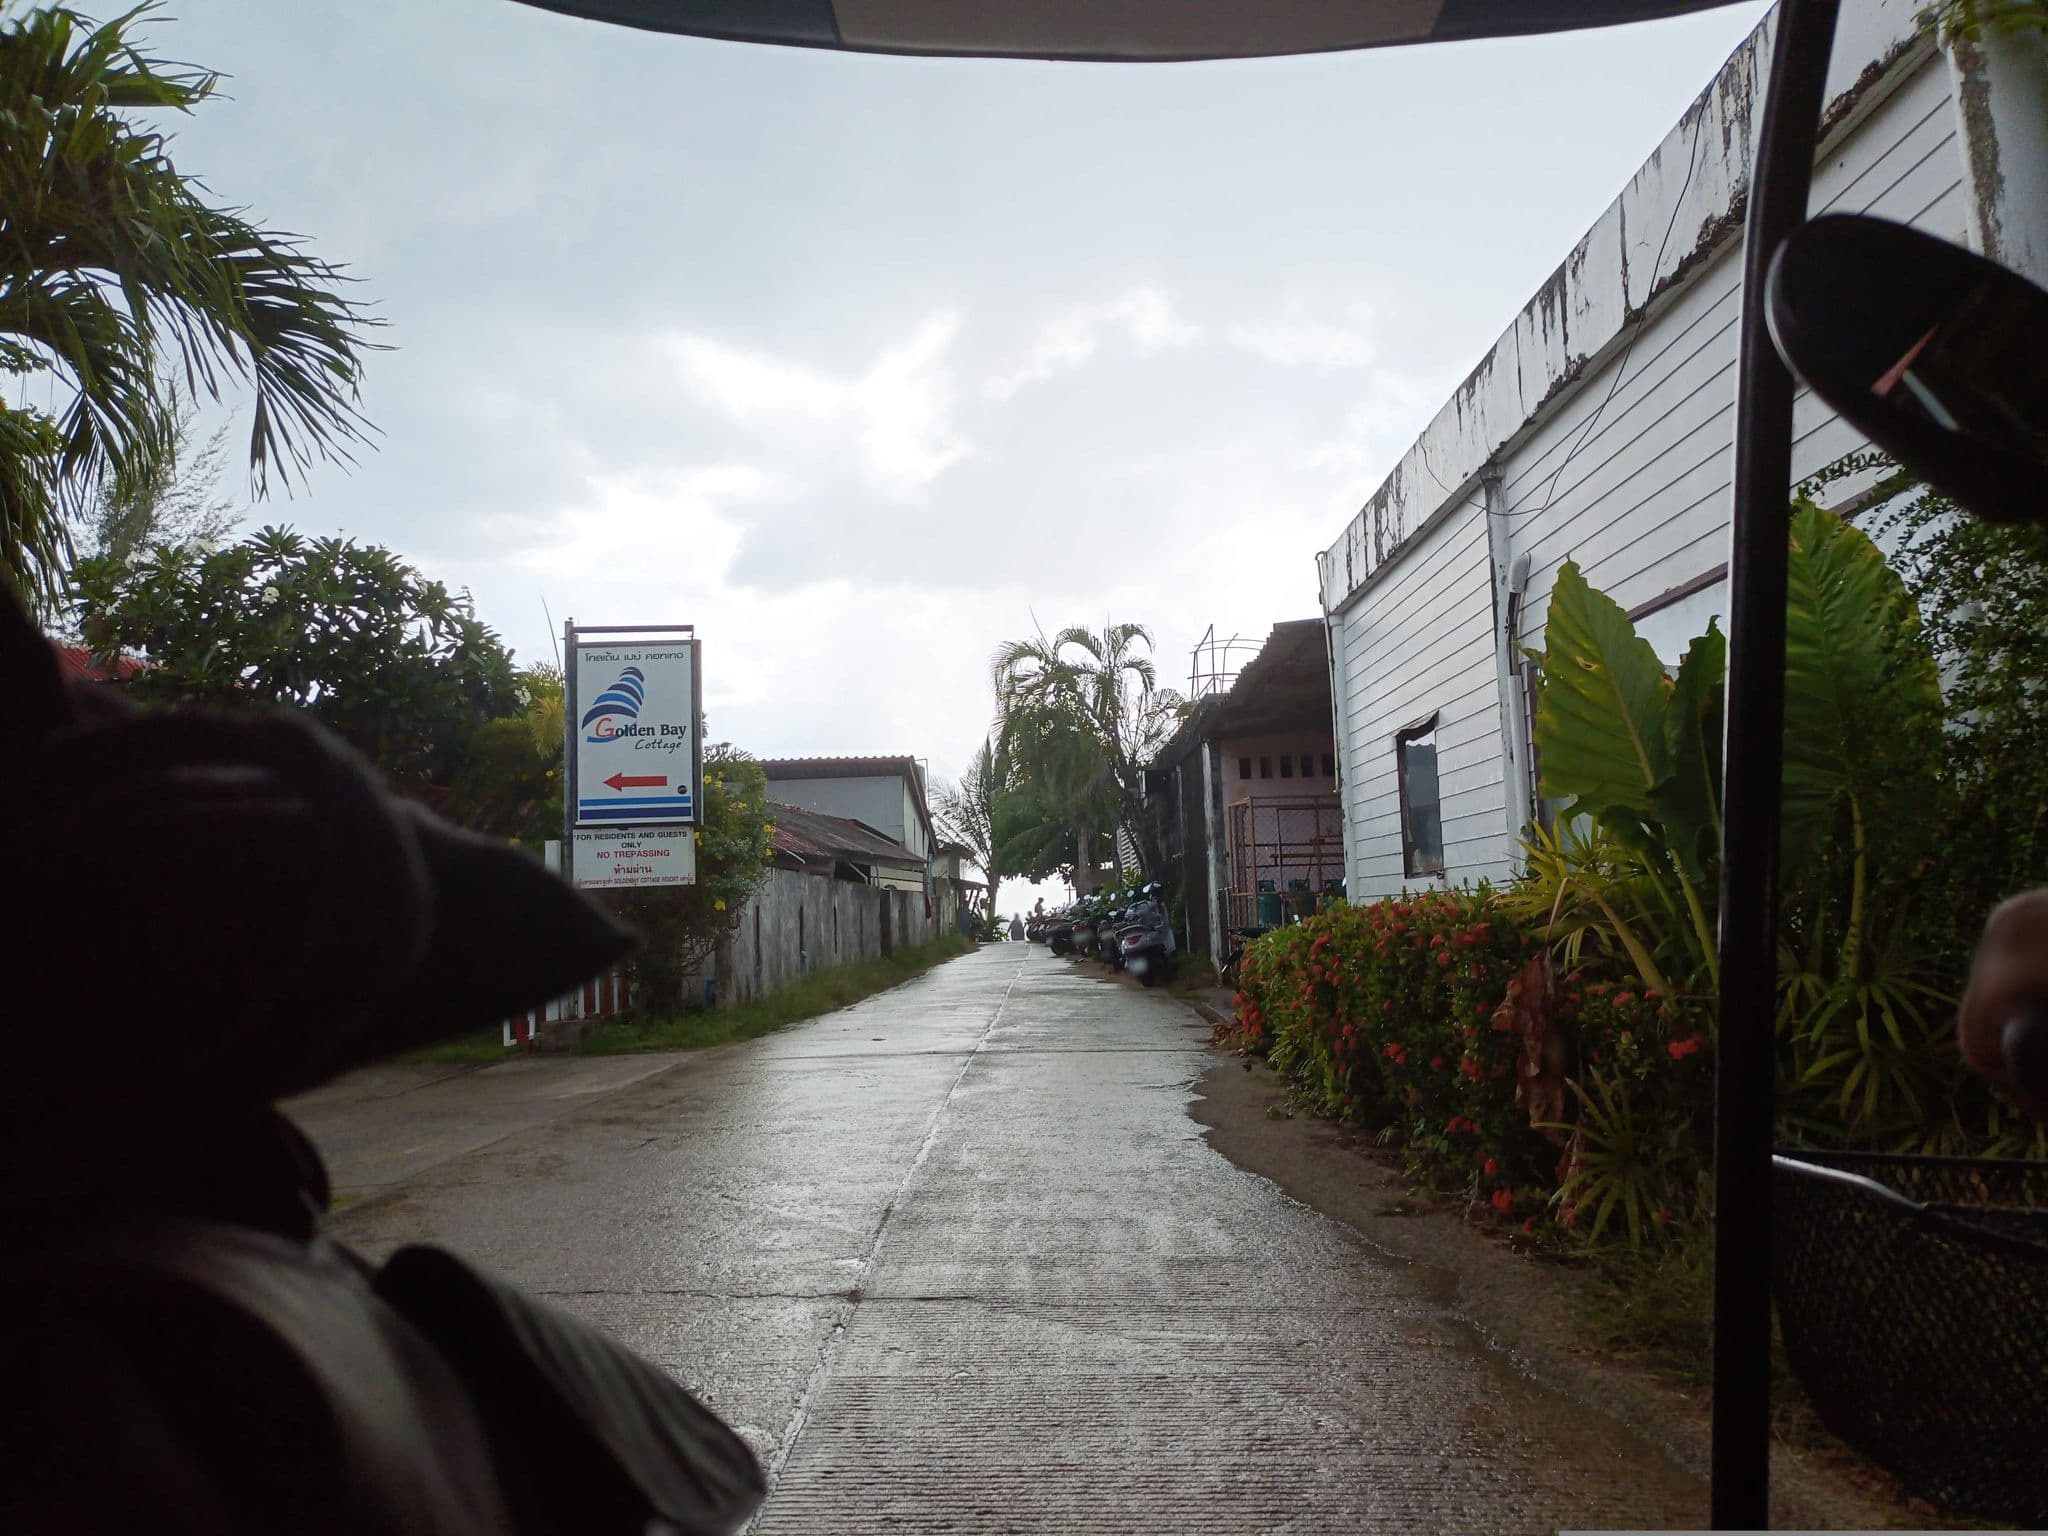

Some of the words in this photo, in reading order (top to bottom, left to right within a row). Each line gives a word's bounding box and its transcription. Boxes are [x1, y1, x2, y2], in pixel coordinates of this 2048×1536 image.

[595, 717, 655, 738] Golden
[661, 724, 687, 739] Bay
[634, 739, 682, 754] Cottage
[594, 832, 636, 840] RESIDENTS
[596, 851, 610, 859] NO
[613, 849, 670, 859] TREPASSING
[613, 863, 653, 875] ห้ามผ่าน
